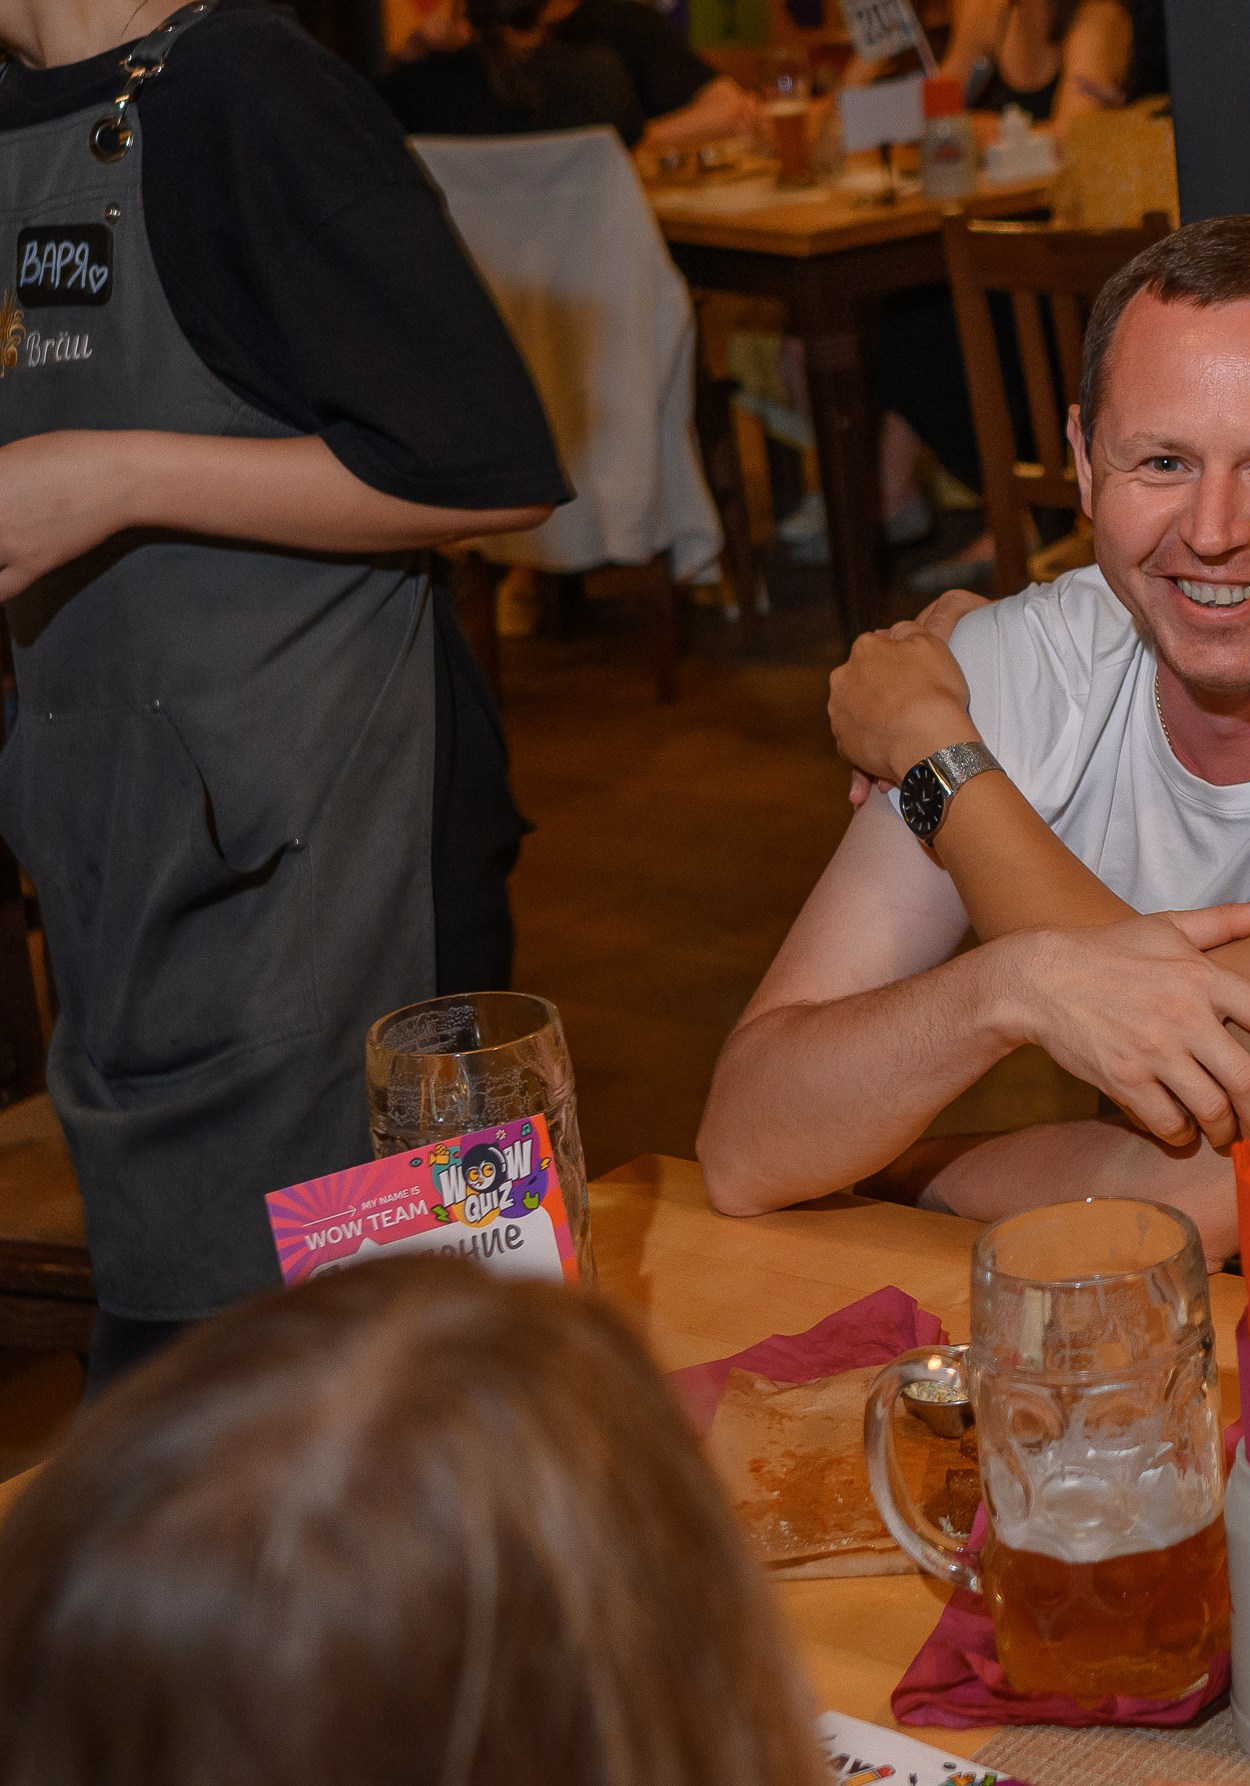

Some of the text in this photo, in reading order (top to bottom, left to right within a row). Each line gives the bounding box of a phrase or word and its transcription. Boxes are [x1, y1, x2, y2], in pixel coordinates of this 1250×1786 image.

[19, 239, 89, 289] ВАРЯ
[26, 330, 93, 368] Bräu
[360, 1185, 421, 1211] MY NAME IS
[463, 1180, 515, 1225] QUIZ
[304, 1218, 363, 1251] WOW
[366, 1199, 430, 1232] TEAM
